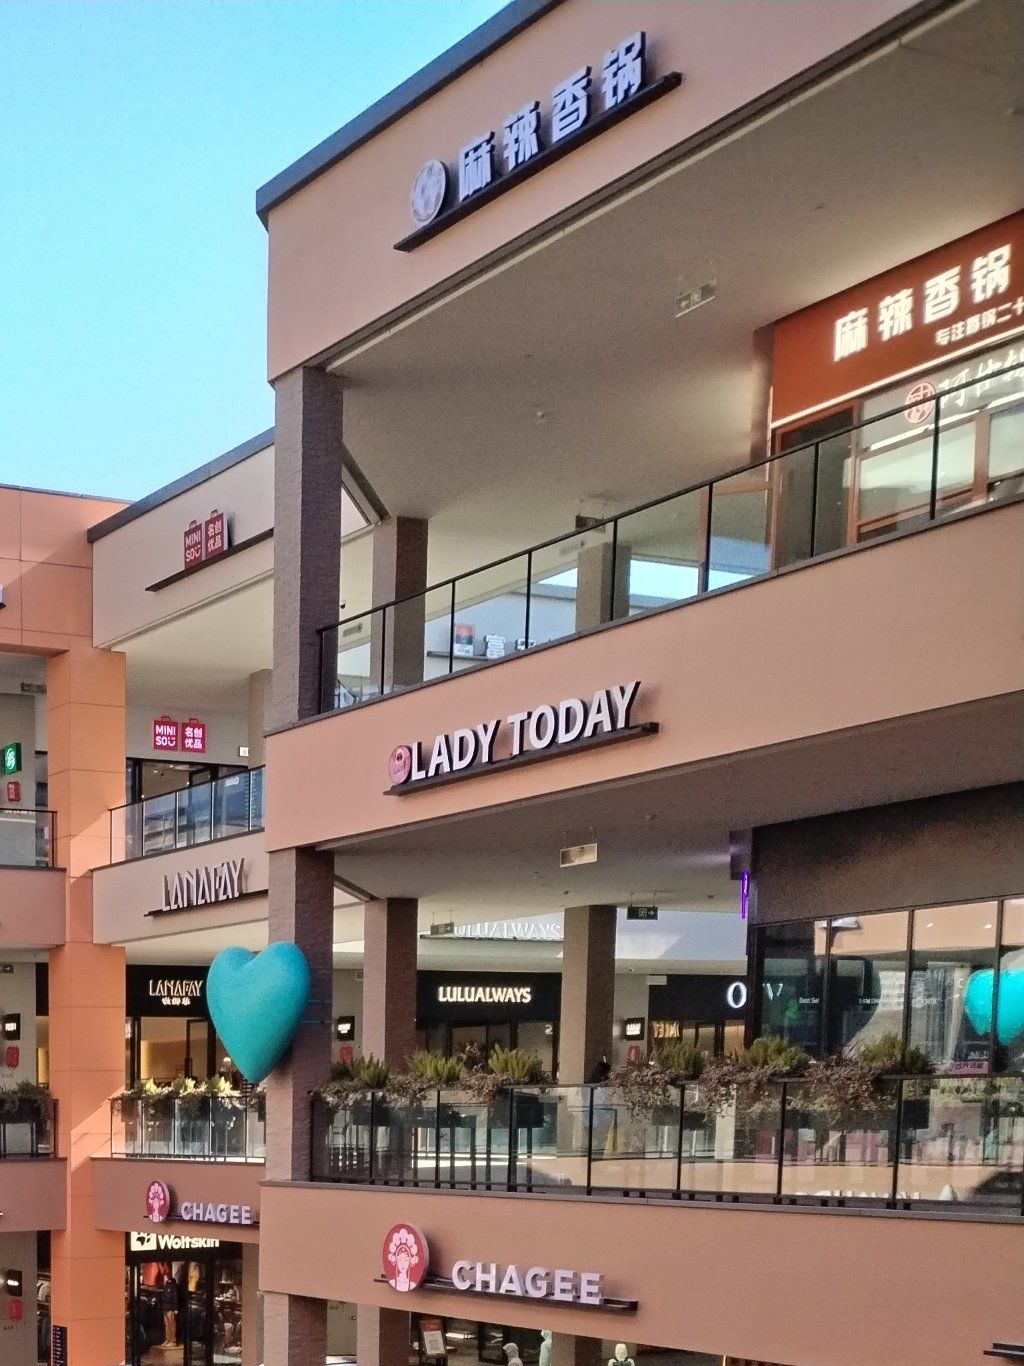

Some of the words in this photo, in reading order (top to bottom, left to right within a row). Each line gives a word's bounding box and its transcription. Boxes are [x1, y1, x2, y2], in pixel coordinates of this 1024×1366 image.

[458, 31, 646, 203] 麻辣香锅
[833, 244, 1012, 361] 麻辣香锅
[185, 529, 202, 549] MINI
[155, 724, 176, 736] MINI
[184, 726, 203, 738] 名创
[411, 719, 500, 782] LADY
[507, 680, 642, 756] TODAY
[184, 737, 203, 749] 优品
[454, 922, 561, 940] ULUALWAYS
[438, 986, 532, 1004] LULUALWAYS
[181, 1202, 252, 1225] CHAGEE
[451, 1259, 604, 1306] CHAGEE
